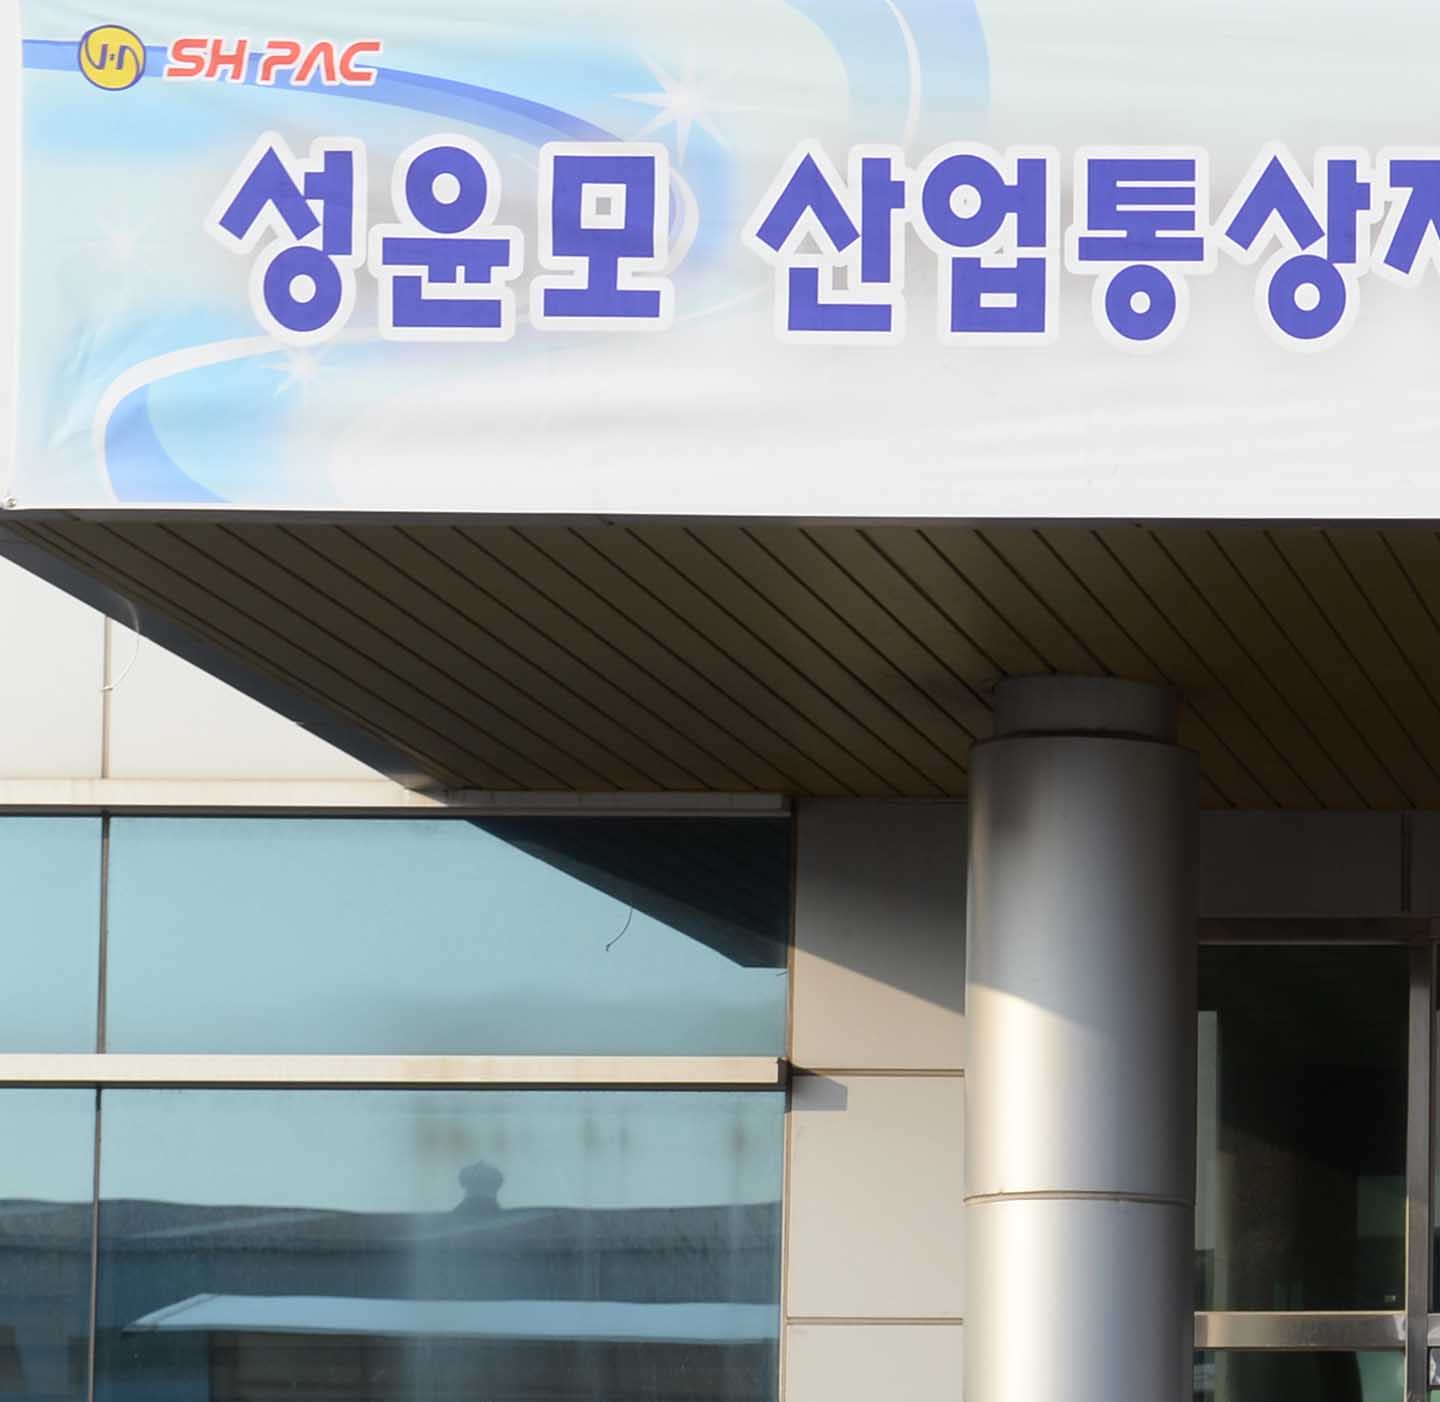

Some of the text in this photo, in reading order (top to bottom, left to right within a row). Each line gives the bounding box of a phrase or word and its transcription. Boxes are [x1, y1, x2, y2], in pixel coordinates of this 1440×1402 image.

[166, 38, 380, 82] SH PAC
[219, 145, 661, 333] 성윤모
